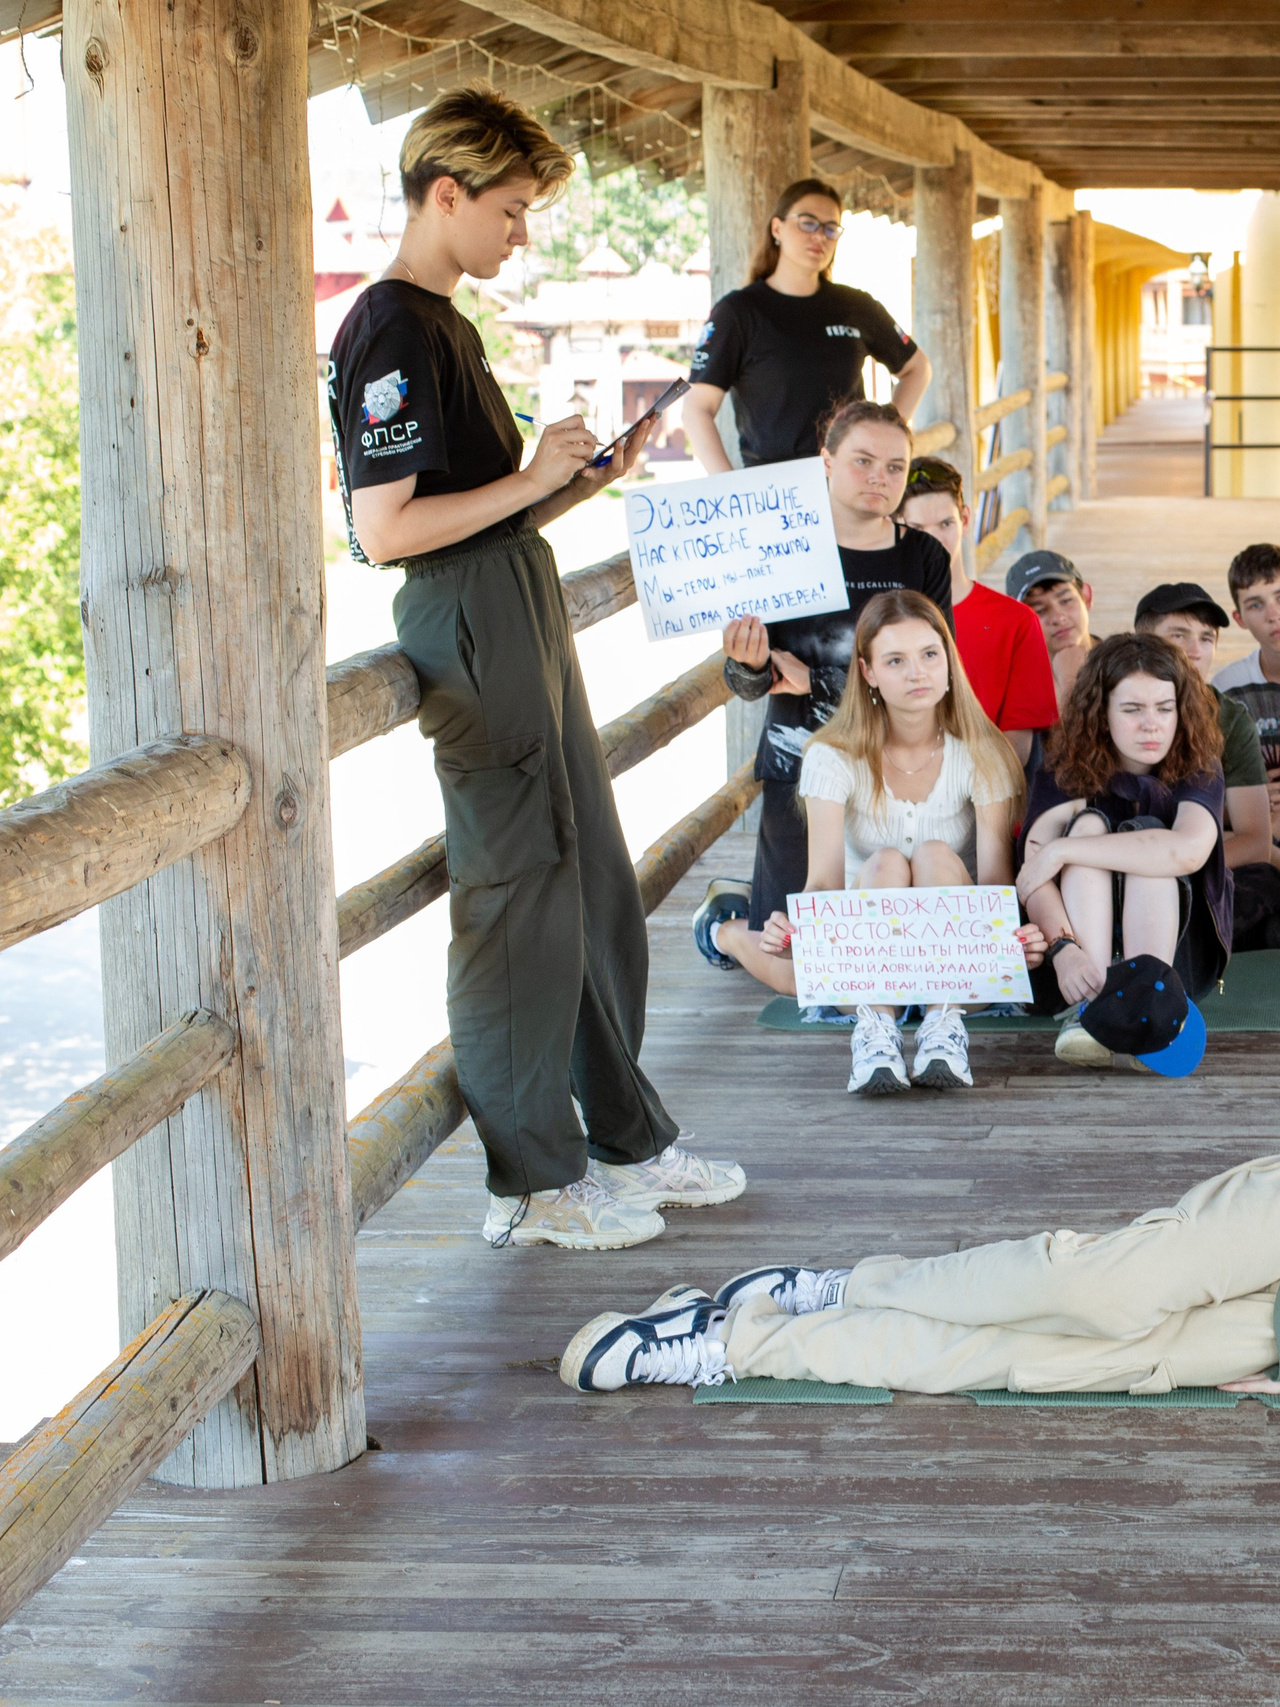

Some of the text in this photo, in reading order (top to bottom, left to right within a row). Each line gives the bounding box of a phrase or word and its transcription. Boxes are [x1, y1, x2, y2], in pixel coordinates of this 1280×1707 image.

[361, 421, 419, 448] ФПСР
[782, 486, 803, 511] НЕ
[780, 510, 820, 530] ЗЕВАЙ
[636, 528, 811, 568] НАС К ПОБЕДЕ ЗАЖИГАЙ
[651, 613, 684, 638] НАШ
[795, 896, 863, 919] НАШ
[881, 892, 1002, 916] ВОЖАТЫЙ
[798, 922, 891, 941] ПРОСТО
[802, 946, 826, 958] НЕ
[932, 944, 951, 957] ТЫ
[957, 943, 998, 956] МИМО
[832, 979, 876, 992] СОБОЙ
[926, 978, 973, 991] ГЕРОЙ!
